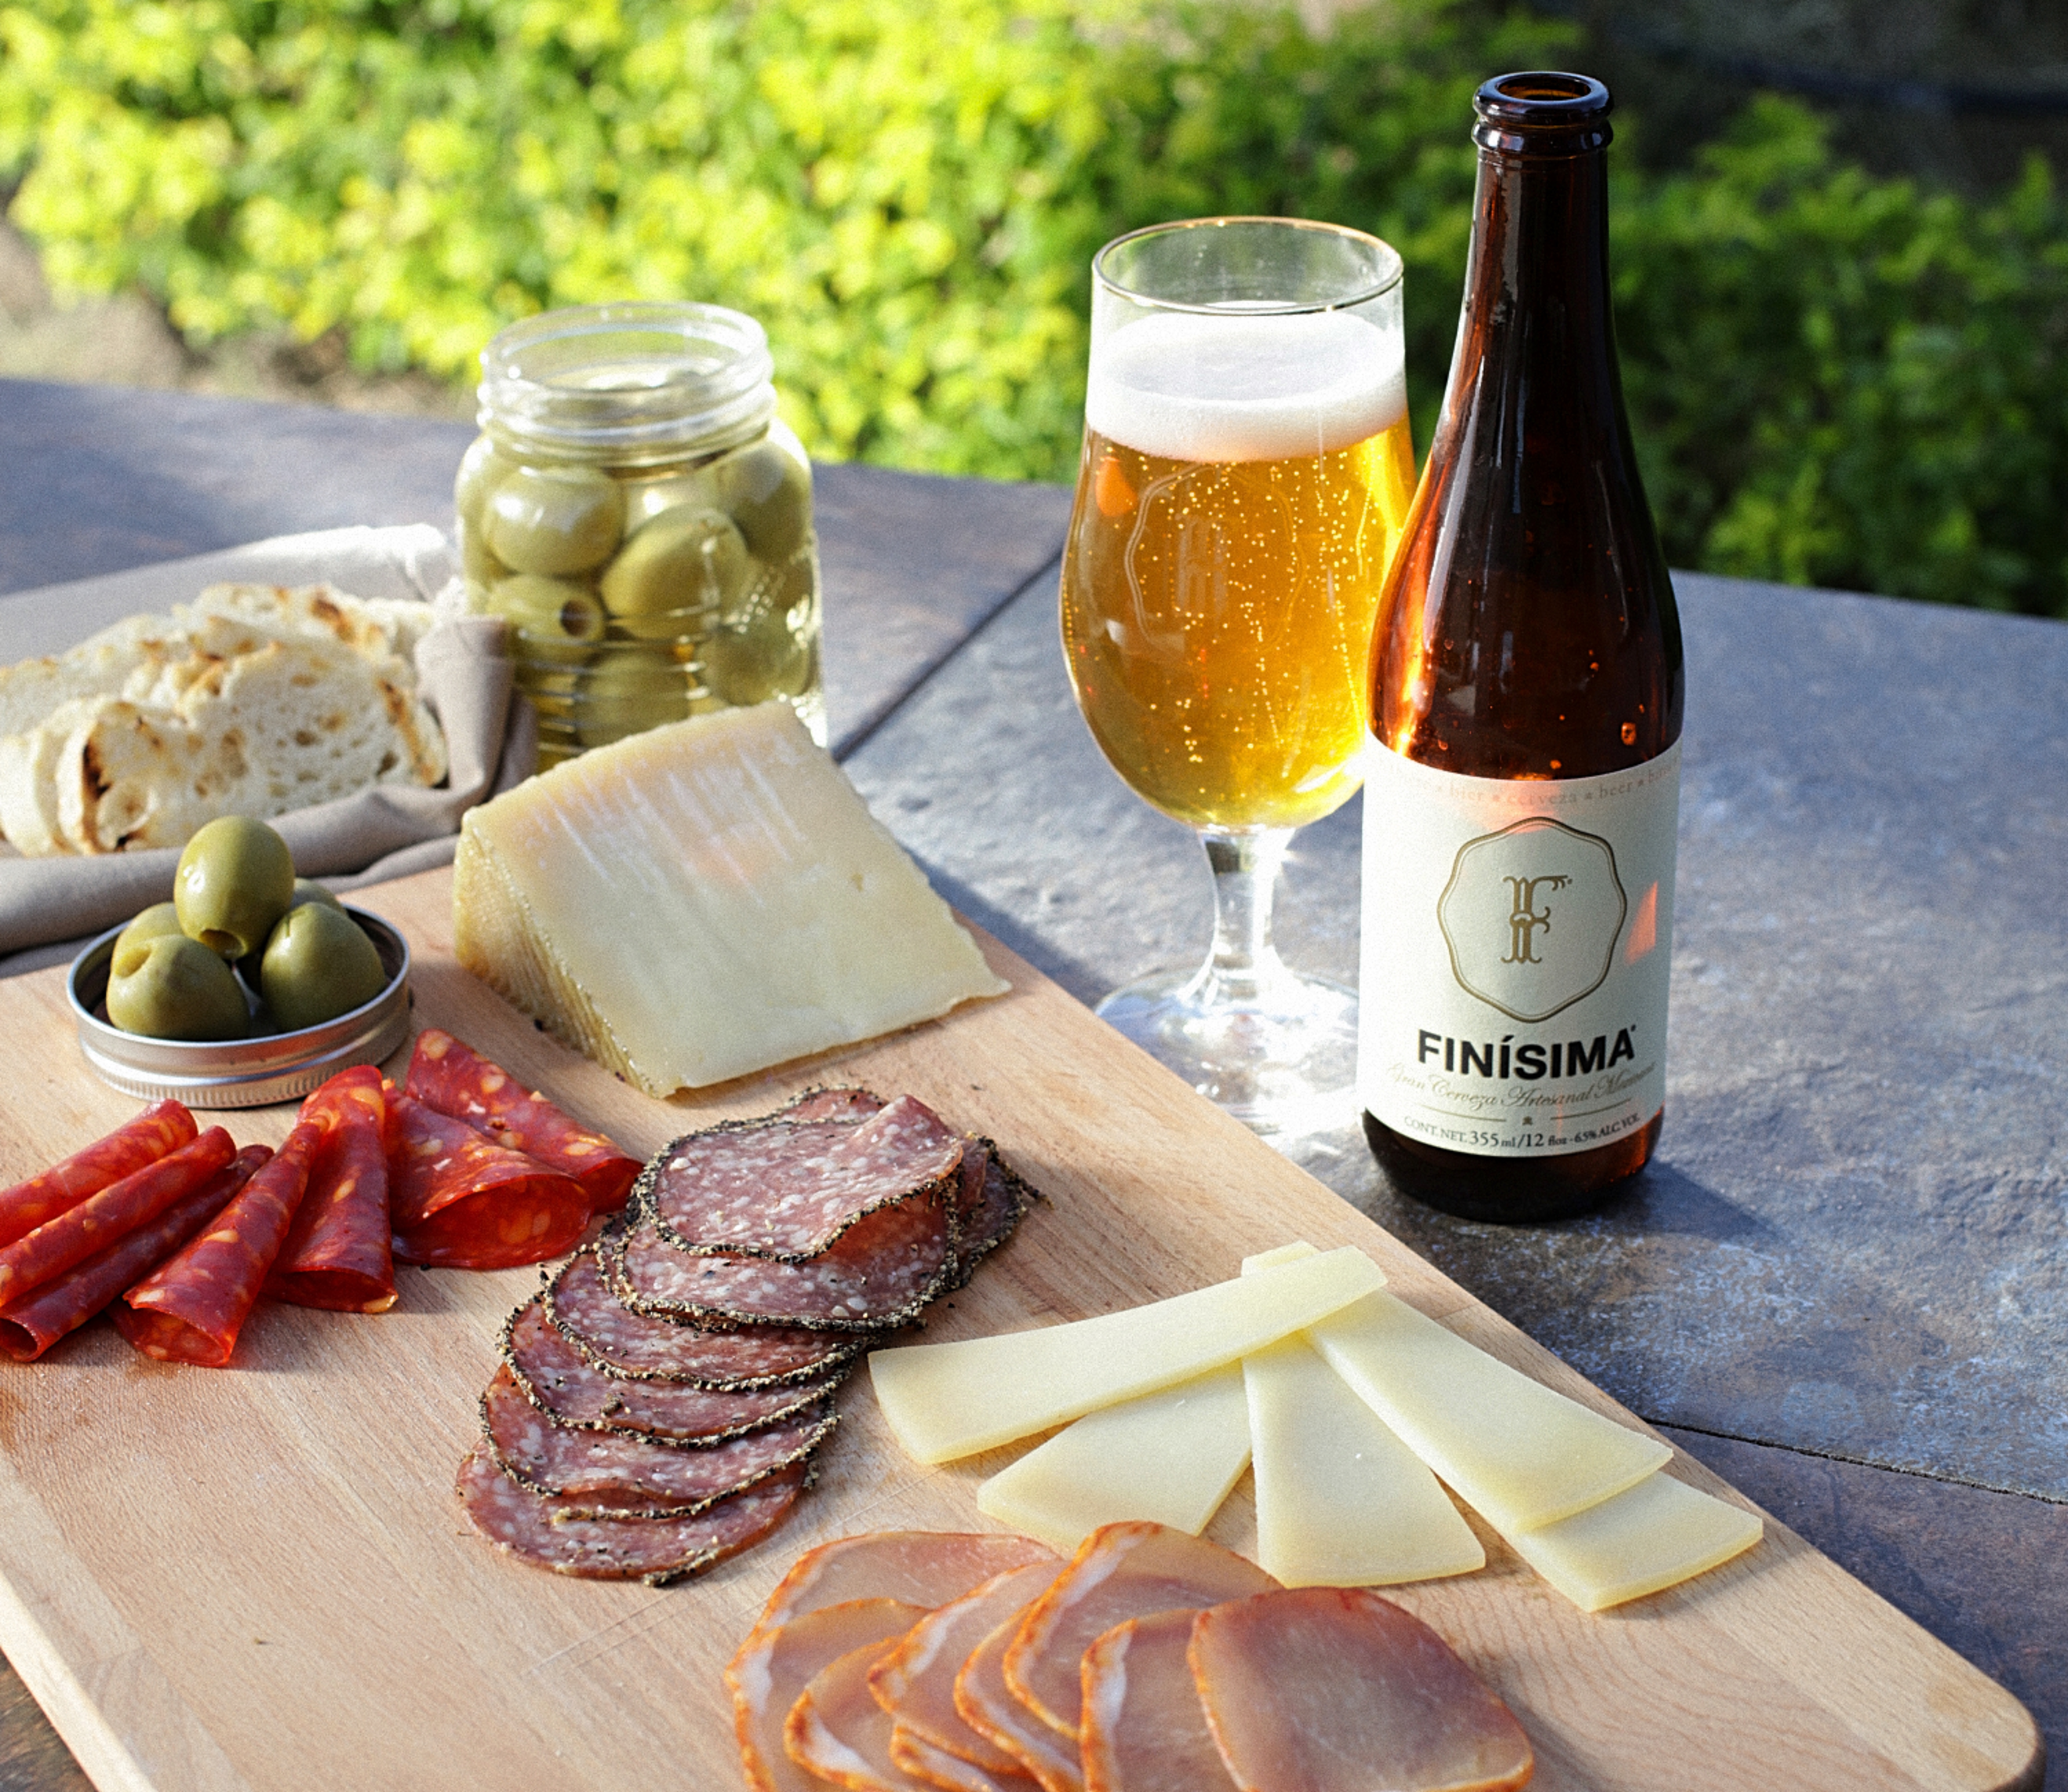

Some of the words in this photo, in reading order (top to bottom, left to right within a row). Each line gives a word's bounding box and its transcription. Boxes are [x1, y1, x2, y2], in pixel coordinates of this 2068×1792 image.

[1599, 781, 1633, 799] beer
[1418, 1027, 1635, 1080] FINÍSIMA
[1429, 1074, 1497, 1111] Cerveza
[1501, 1083, 1595, 1108] Artesanal
